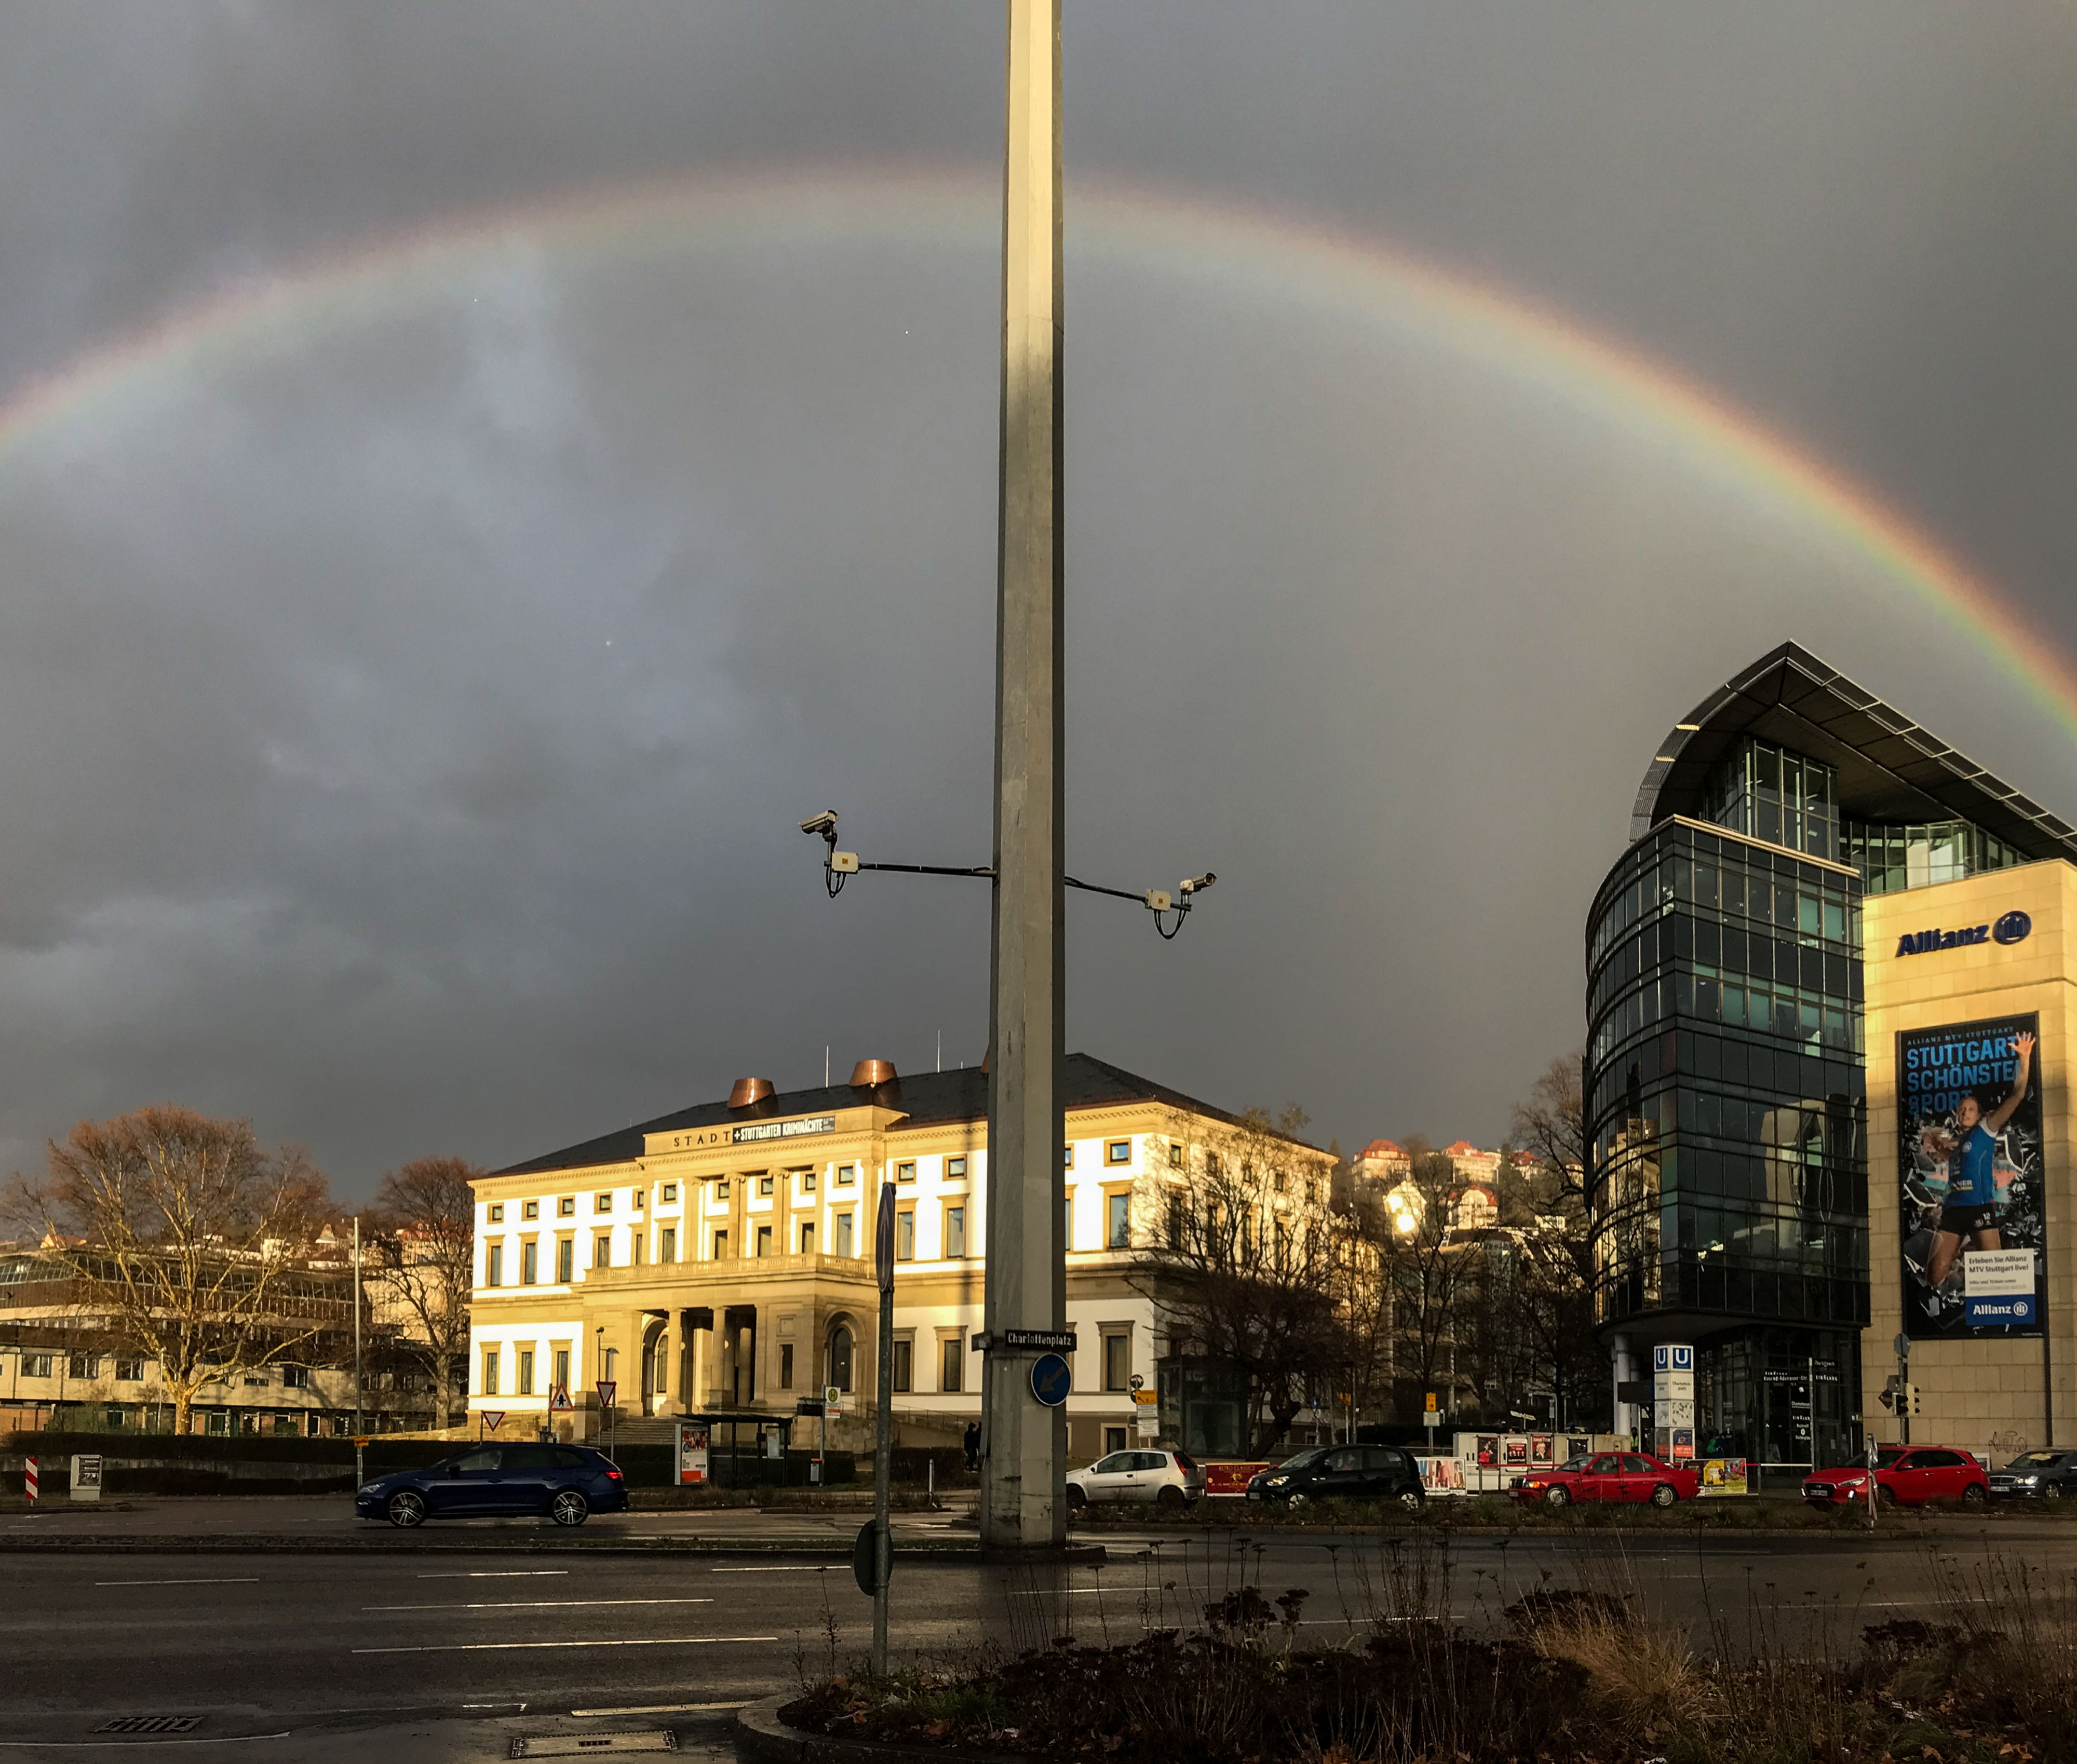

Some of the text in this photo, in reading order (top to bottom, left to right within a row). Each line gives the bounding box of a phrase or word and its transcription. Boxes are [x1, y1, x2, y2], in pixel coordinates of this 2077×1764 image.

[1895, 925, 1990, 958] Allianz
[1907, 1036, 1941, 1046] ALLIANZ
[1966, 1026, 2014, 1038] STUTTGART
[1907, 1035, 2027, 1069] STUTTGART
[783, 1118, 824, 1136] KRIMINÄCHTE
[674, 1131, 731, 1147] STADT
[1973, 1304, 2012, 1315] Allianz
[1008, 1332, 1072, 1347] Charlottenplatz
[1657, 1349, 1666, 1364] U
[1675, 1349, 1688, 1364] U
